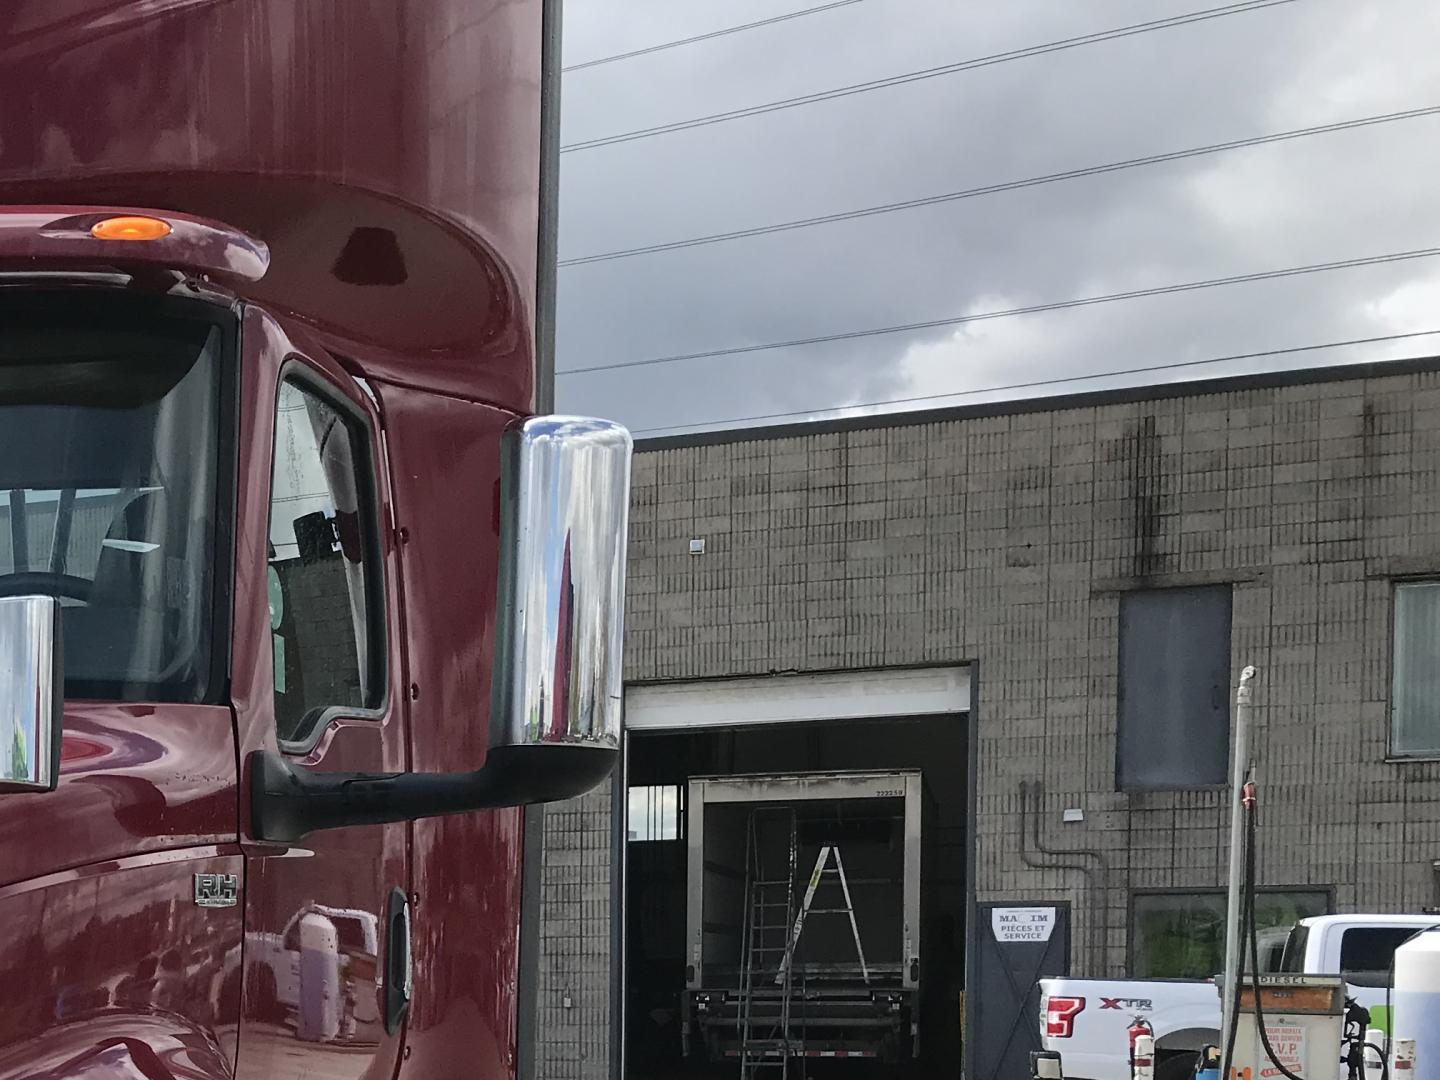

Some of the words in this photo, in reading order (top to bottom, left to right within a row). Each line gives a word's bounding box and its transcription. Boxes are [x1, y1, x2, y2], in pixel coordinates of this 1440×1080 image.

[195, 873, 237, 899] RH
[1004, 932, 1042, 940] SERVICE
[1260, 976, 1307, 985] DIESEL
[1098, 997, 1153, 1009] XTR
